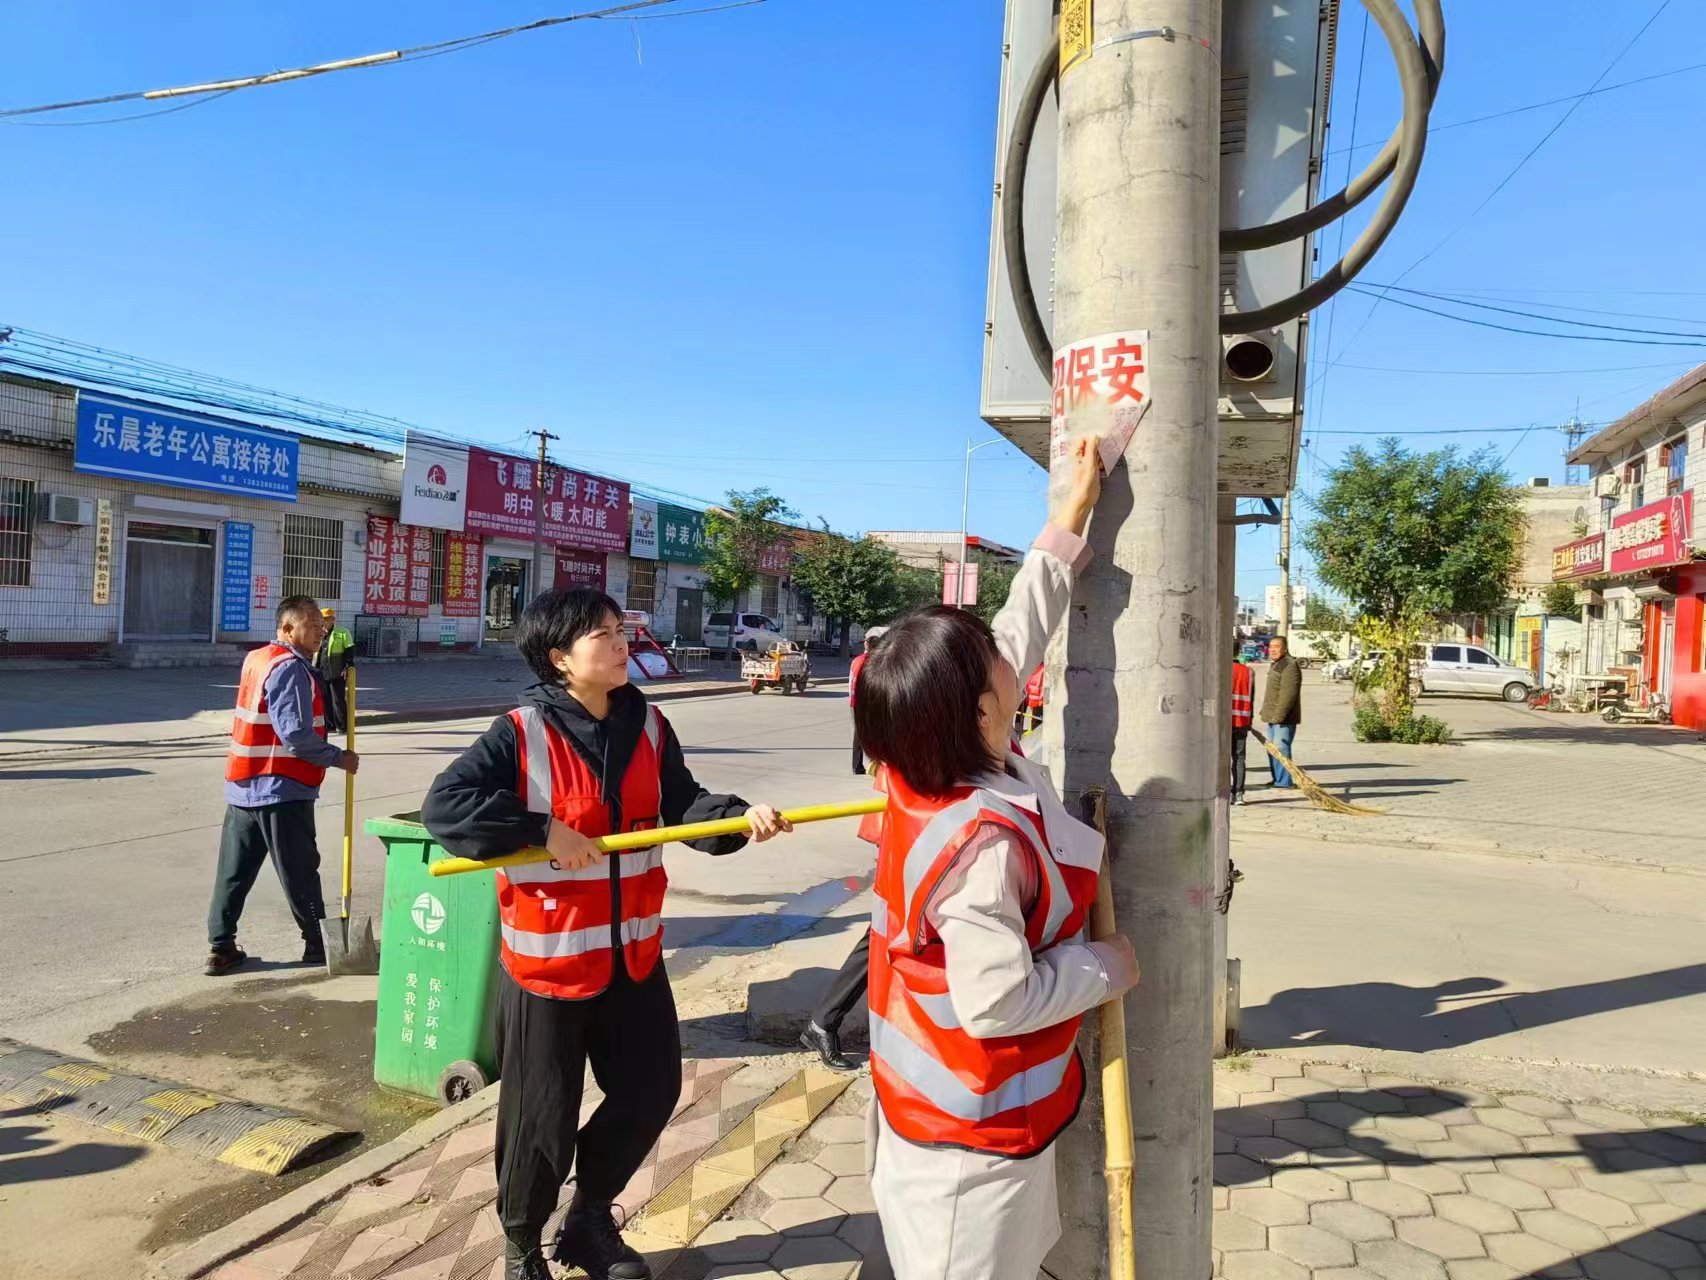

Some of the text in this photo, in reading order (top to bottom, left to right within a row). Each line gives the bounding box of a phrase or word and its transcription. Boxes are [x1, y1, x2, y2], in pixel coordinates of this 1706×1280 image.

[92, 413, 289, 478] 乐晨老年公寓接待处
[366, 517, 388, 600] 专业防水
[388, 521, 409, 602] 修补漏房顶
[448, 541, 464, 598] 维修壁挂炉
[464, 543, 479, 599] 壁挂炉冲洗
[559, 560, 602, 575] 飞雕时尚开关
[254, 575, 268, 609] 招工
[409, 936, 446, 952] 人和环境
[401, 972, 418, 1044] 爱我家园
[424, 977, 442, 1050] 保护环境
